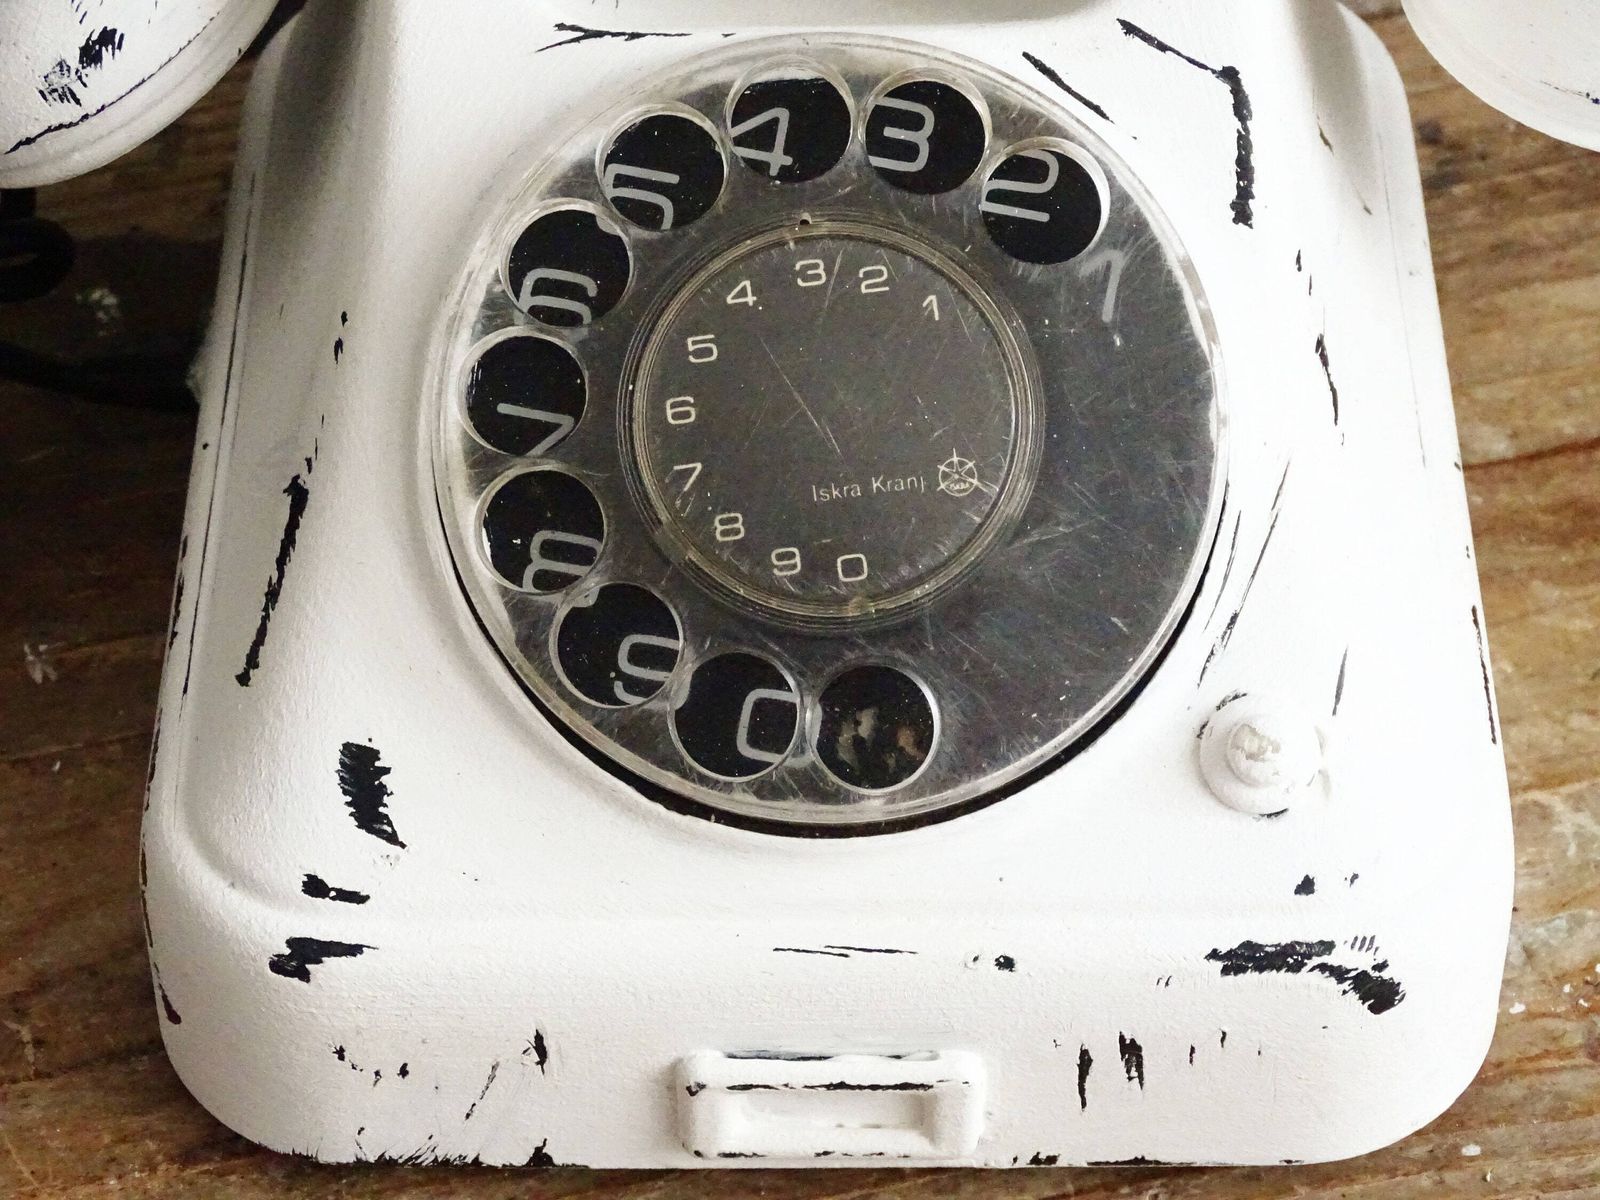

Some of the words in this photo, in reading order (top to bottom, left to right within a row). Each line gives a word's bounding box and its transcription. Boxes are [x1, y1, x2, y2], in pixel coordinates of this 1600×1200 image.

[727, 107, 794, 177] 4
[863, 96, 936, 173] 3
[598, 163, 680, 237] 5
[979, 149, 1060, 223] 2
[794, 258, 827, 288] 3
[858, 264, 890, 295] 2
[1079, 250, 1126, 323] 1
[515, 267, 599, 338] 6
[726, 279, 758, 307] 4
[921, 294, 941, 322] 1
[687, 333, 719, 364] 5
[665, 395, 696, 425] 6
[496, 402, 576, 464] 7
[672, 461, 703, 493] 7
[811, 482, 863, 502] Iskra
[871, 474, 926, 494] Kranj
[714, 512, 745, 543] 8
[521, 529, 603, 606] 8
[771, 546, 802, 577] 9
[836, 553, 869, 583] 0
[613, 633, 692, 710] 9
